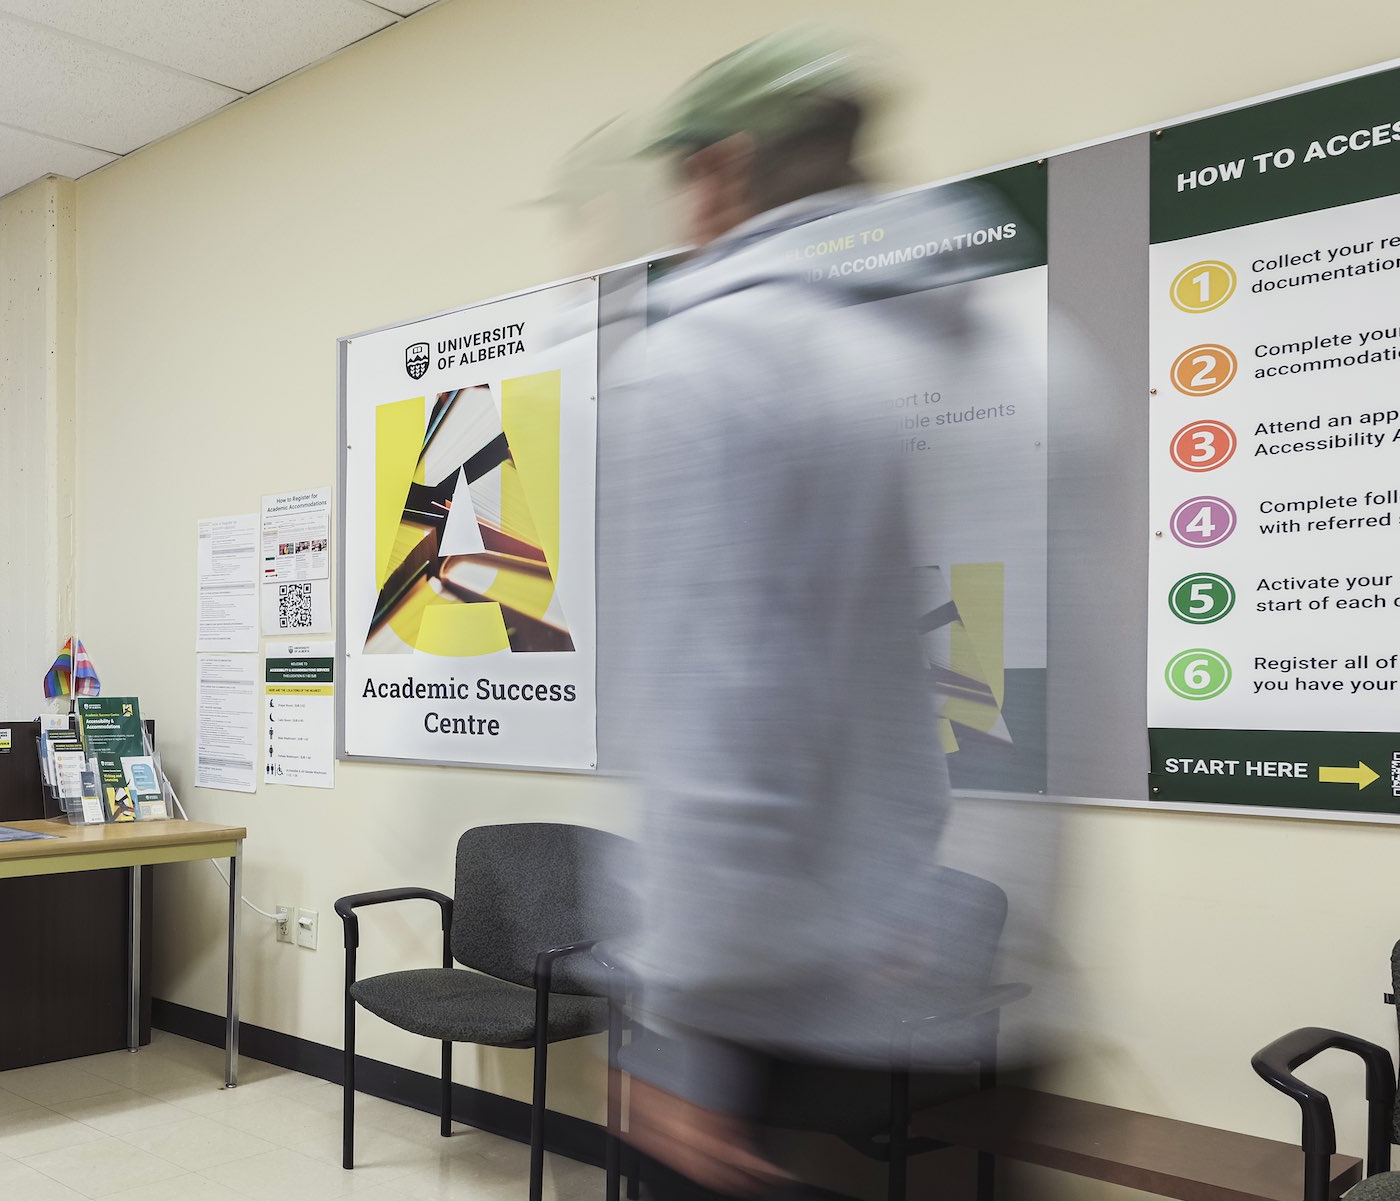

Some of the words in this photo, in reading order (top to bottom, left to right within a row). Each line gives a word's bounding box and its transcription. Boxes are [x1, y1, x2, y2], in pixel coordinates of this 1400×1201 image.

[1176, 158, 1245, 192] HOW
[1252, 148, 1296, 174] TO
[828, 222, 1017, 280] ACCOMMODATIONS
[860, 228, 884, 245] TO
[1192, 271, 1211, 302] 1
[1252, 249, 1321, 273] Collect
[1328, 241, 1374, 263] your
[1252, 258, 1400, 294] documentatio
[437, 322, 525, 354] UNIVERSITY
[437, 355, 456, 371] OF
[460, 341, 525, 366] ALBERTA
[1190, 355, 1216, 387] 2
[1255, 334, 1352, 358] Complete
[1359, 328, 1400, 346] you
[1255, 346, 1400, 378] accommodati
[924, 391, 941, 404] to
[936, 404, 1016, 425] students
[1190, 431, 1216, 462] 3
[1254, 415, 1320, 436] Attend
[1328, 415, 1352, 427] an
[1254, 432, 1385, 456] Accessibility
[289, 501, 327, 510] Accommodations
[1186, 506, 1216, 537] 4
[1260, 496, 1357, 513] Complete
[1364, 490, 1400, 506] foll
[1260, 520, 1300, 534] with
[1308, 512, 1390, 531] referred
[1189, 583, 1214, 614] 5
[1257, 577, 1339, 591] Activate
[1346, 575, 1393, 591] your
[1256, 599, 1302, 612] start
[1308, 596, 1329, 610] of
[1336, 594, 1386, 609] each
[1184, 659, 1211, 689] 6
[1255, 657, 1338, 672] Register
[1345, 655, 1368, 669] all
[1376, 655, 1398, 669] of
[1253, 679, 1288, 693] you
[1296, 678, 1344, 691] have
[1350, 680, 1398, 694] your
[362, 677, 469, 700] Academic
[476, 679, 576, 701] Success
[424, 712, 500, 735] Centre
[1165, 758, 1239, 775] START
[1246, 761, 1308, 778] HERE
